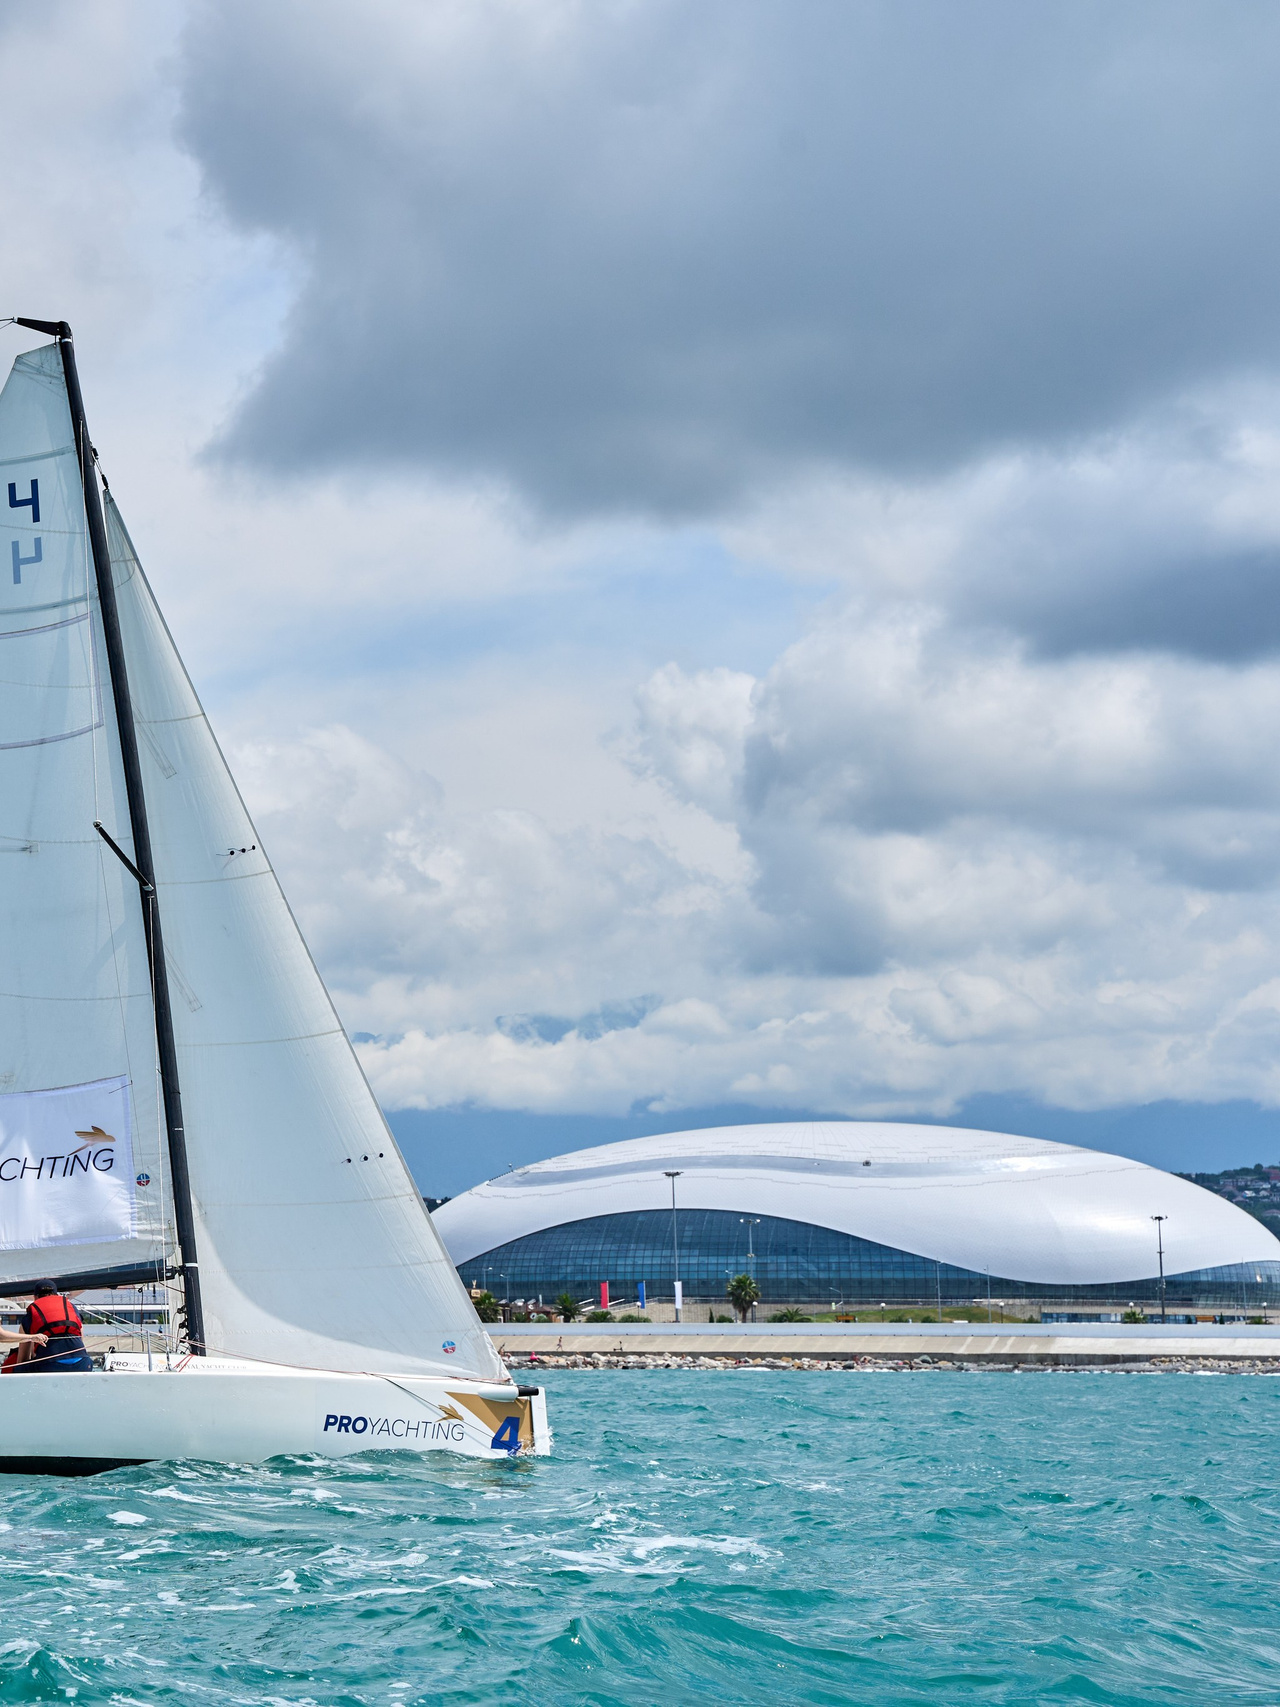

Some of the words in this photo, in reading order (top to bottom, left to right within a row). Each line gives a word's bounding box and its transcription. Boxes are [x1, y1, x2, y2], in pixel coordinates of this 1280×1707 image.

[7, 478, 41, 524] 4
[323, 1414, 465, 1442] PROYACHTING
[491, 1416, 522, 1456] 4
